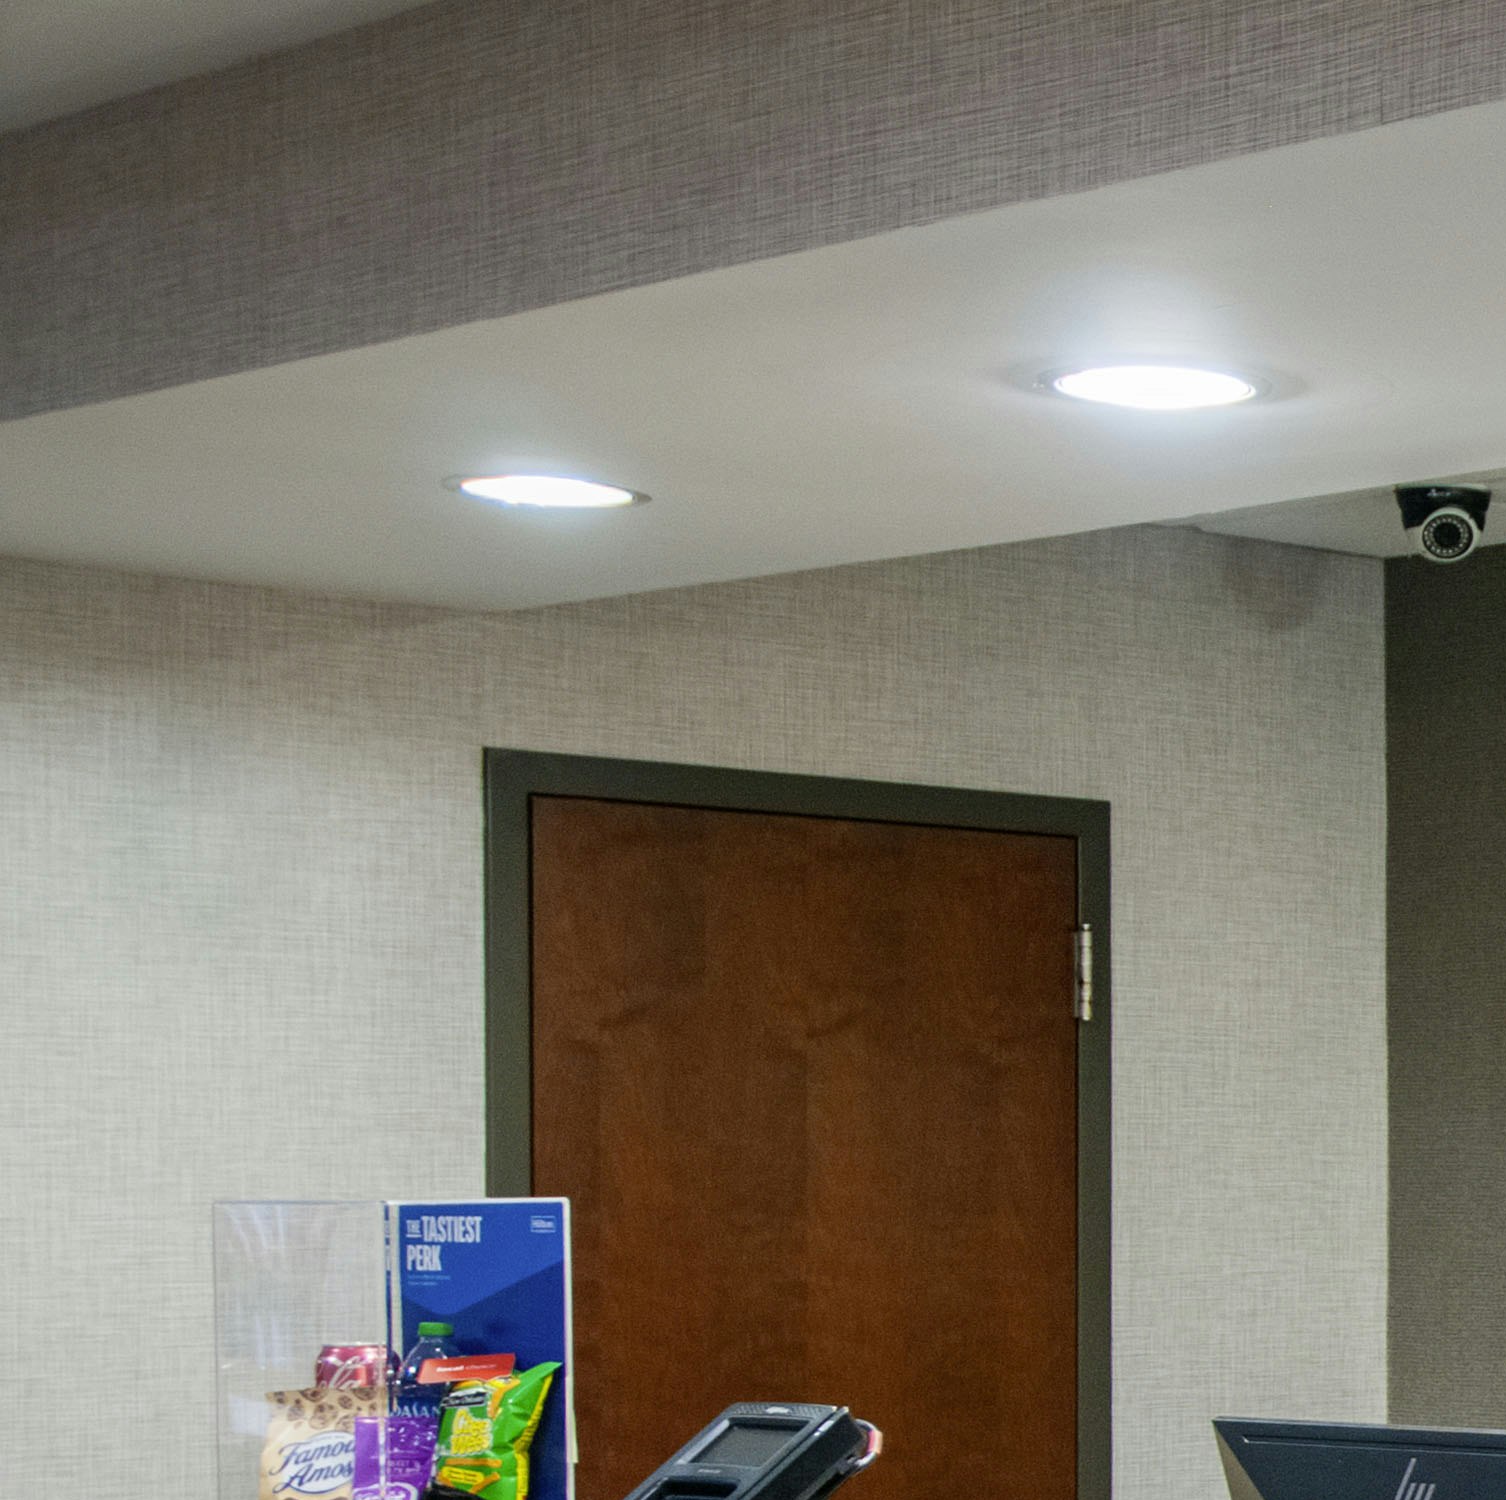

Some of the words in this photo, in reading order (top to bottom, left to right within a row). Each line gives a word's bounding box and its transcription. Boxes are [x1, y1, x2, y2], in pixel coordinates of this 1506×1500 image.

[405, 1219, 421, 1232] THE
[420, 1215, 482, 1243] TASTIEST
[405, 1244, 442, 1272] PERK
[269, 1439, 355, 1476] Famou
[272, 1460, 354, 1494] Amos
